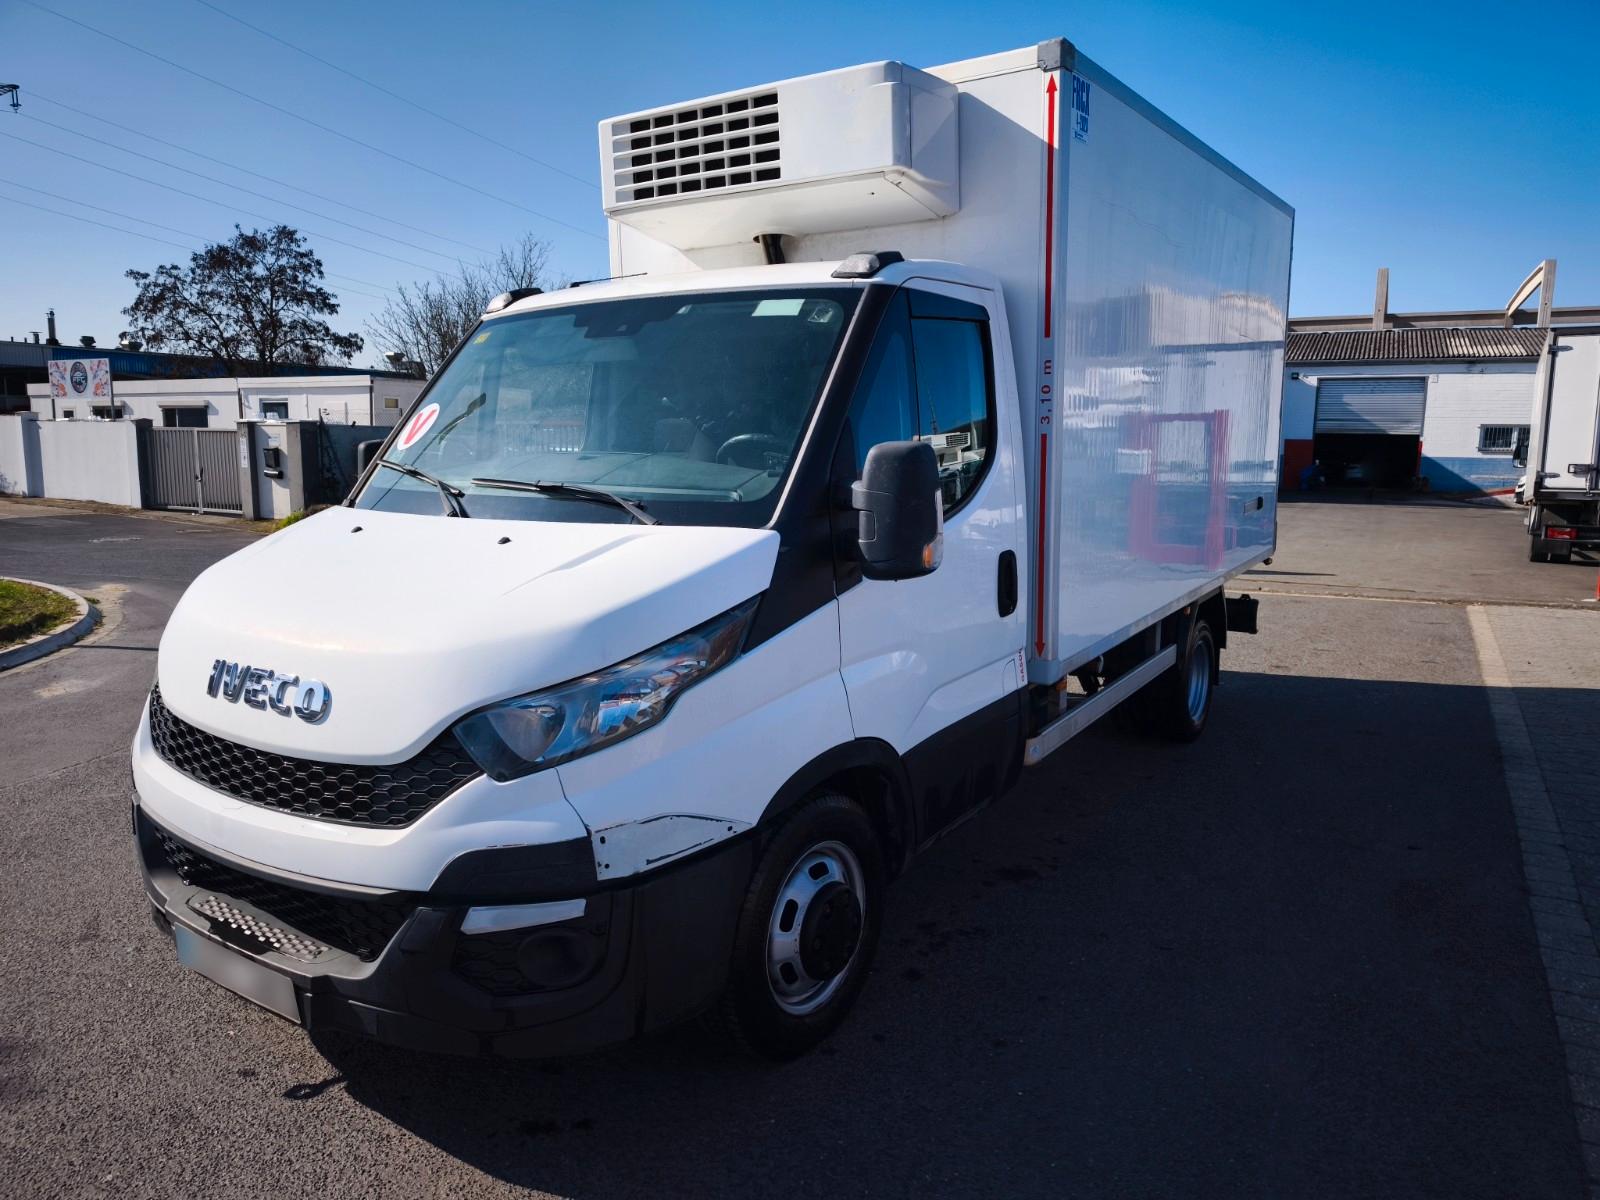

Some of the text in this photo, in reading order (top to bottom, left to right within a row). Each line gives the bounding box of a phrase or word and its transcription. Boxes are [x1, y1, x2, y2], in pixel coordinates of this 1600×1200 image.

[1072, 75, 1091, 116] FRCX
[1043, 359, 1052, 375] m
[403, 409, 437, 445] V
[206, 659, 332, 726] IVECO
